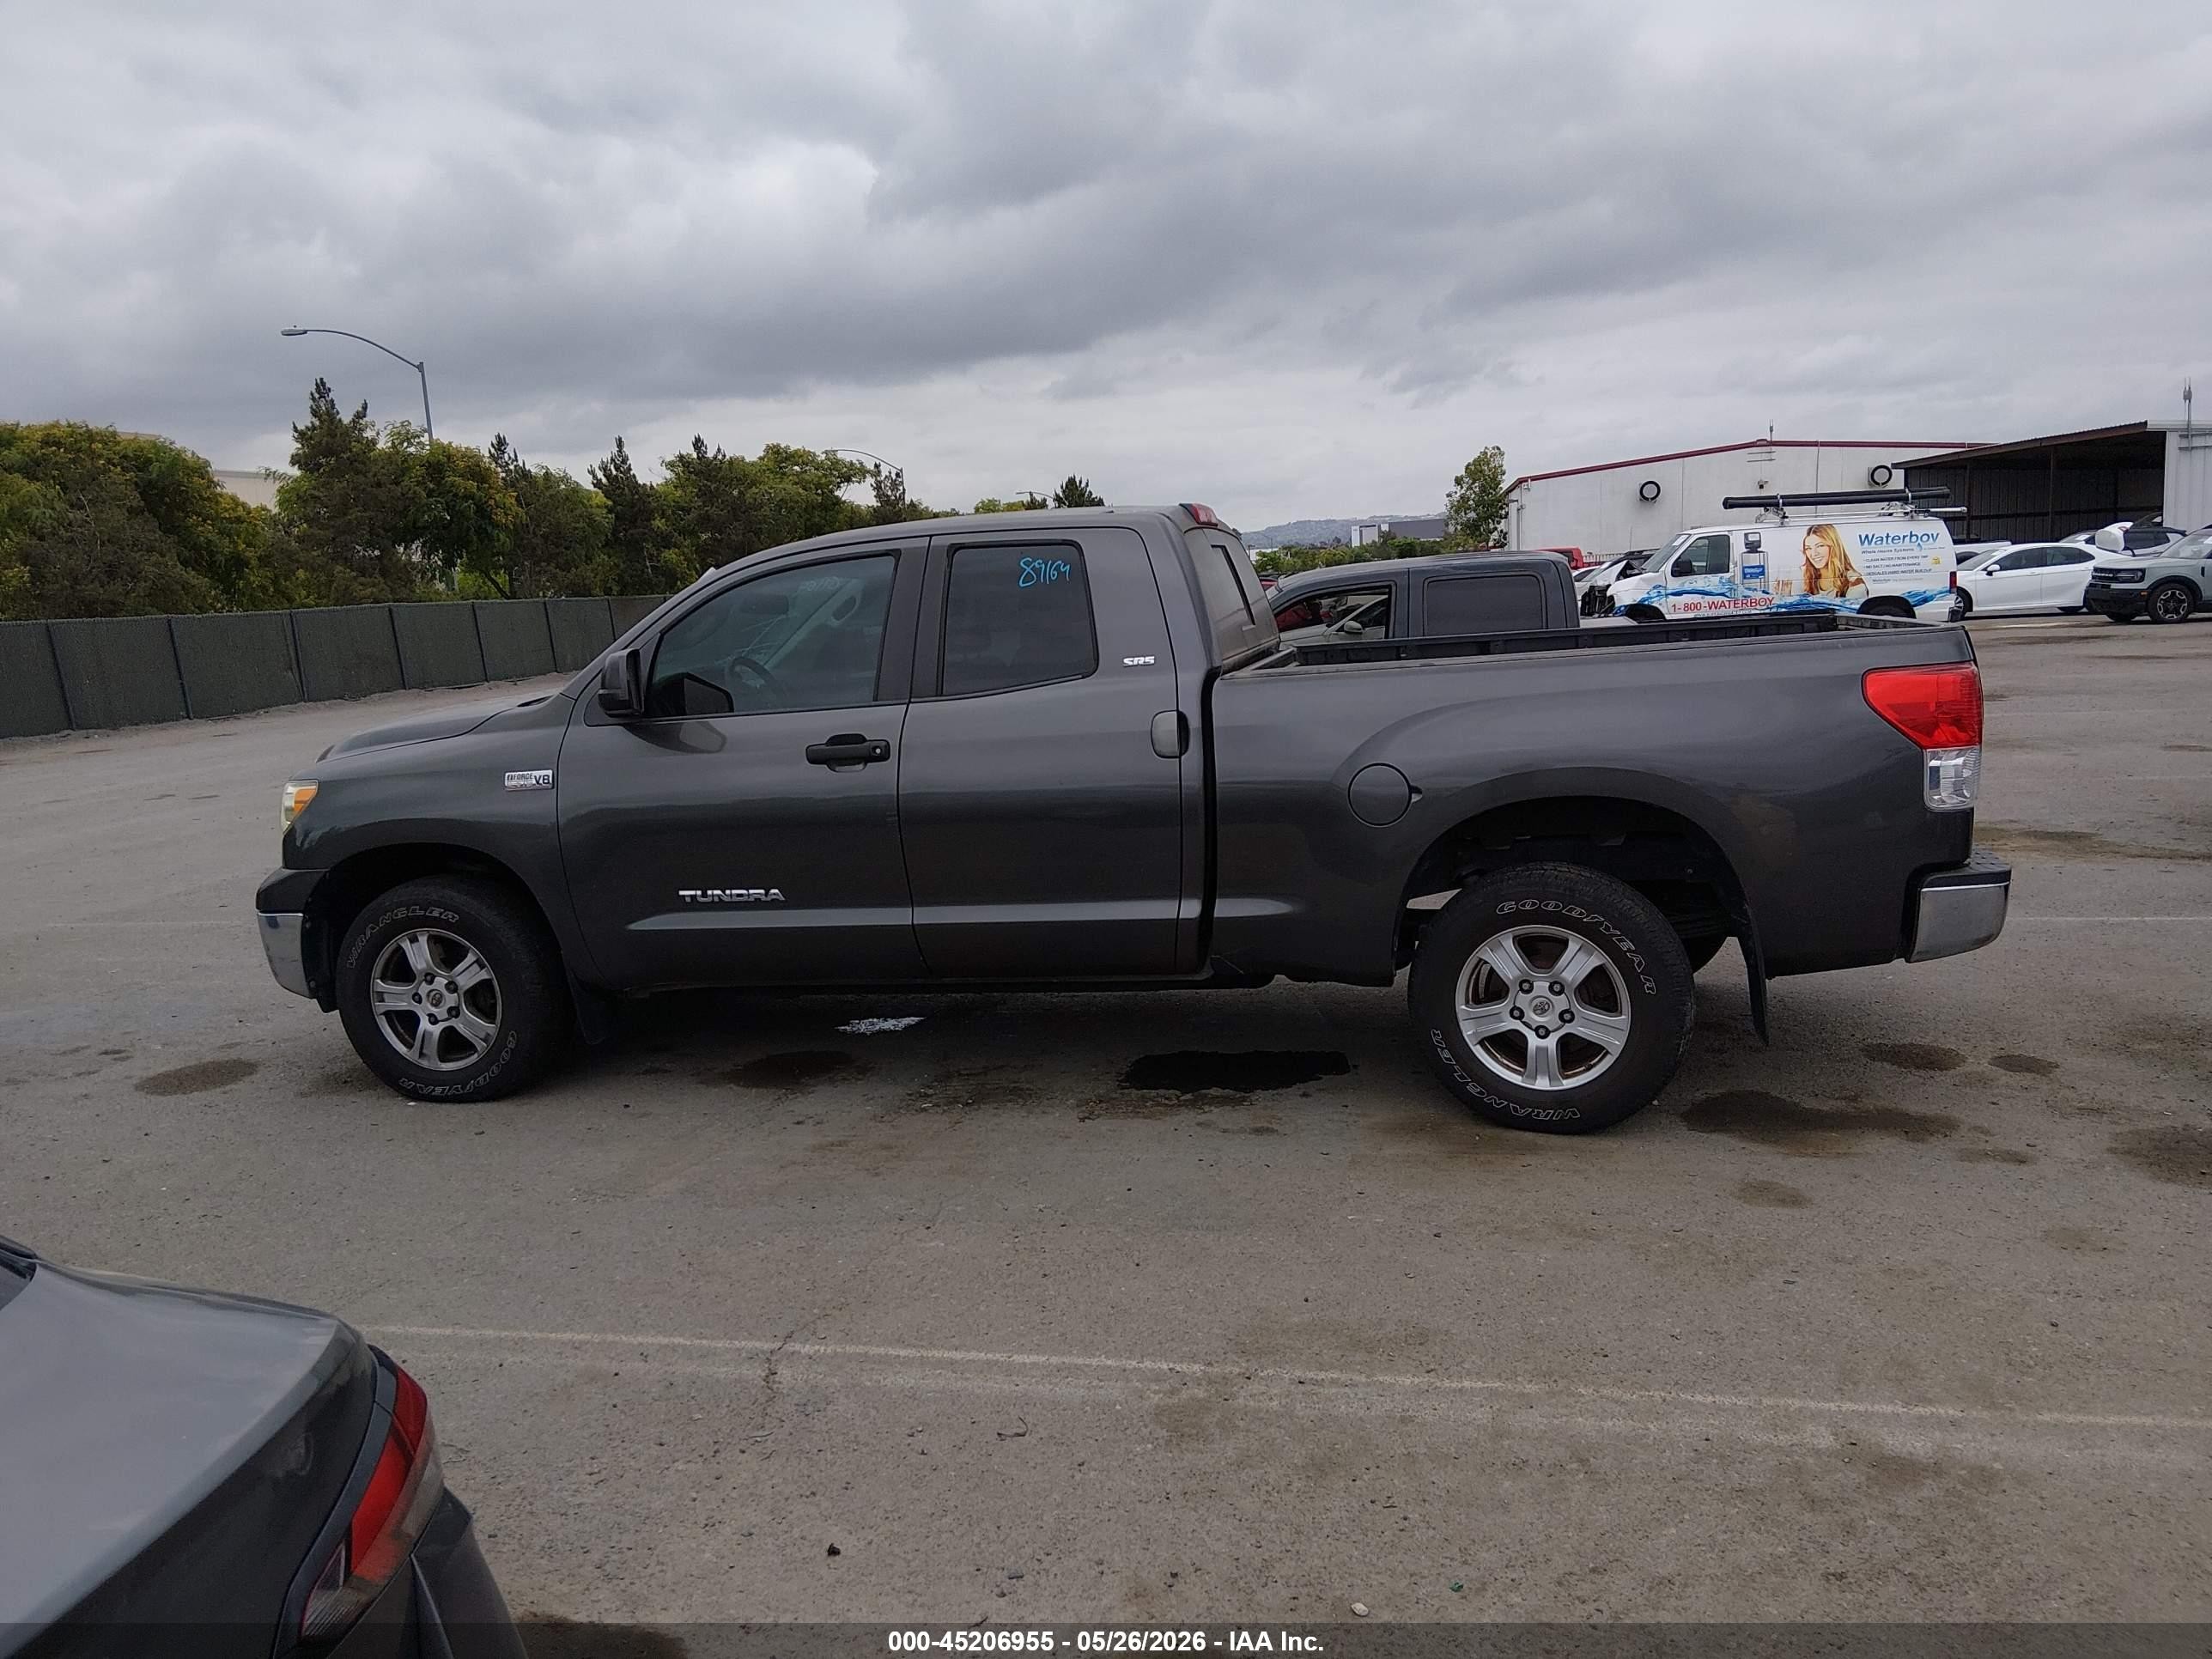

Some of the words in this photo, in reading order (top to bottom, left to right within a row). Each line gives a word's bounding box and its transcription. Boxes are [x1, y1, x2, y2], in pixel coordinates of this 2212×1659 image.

[1123, 656, 1155, 666] SR5
[535, 775, 550, 785] V8
[678, 889, 786, 902] TUNDRA
[346, 905, 461, 969] WRANGLER
[1496, 899, 1658, 995] GOODYEAR
[398, 1030, 518, 1096] GOODYEAR
[1431, 1029, 1582, 1121] WRANGLER
